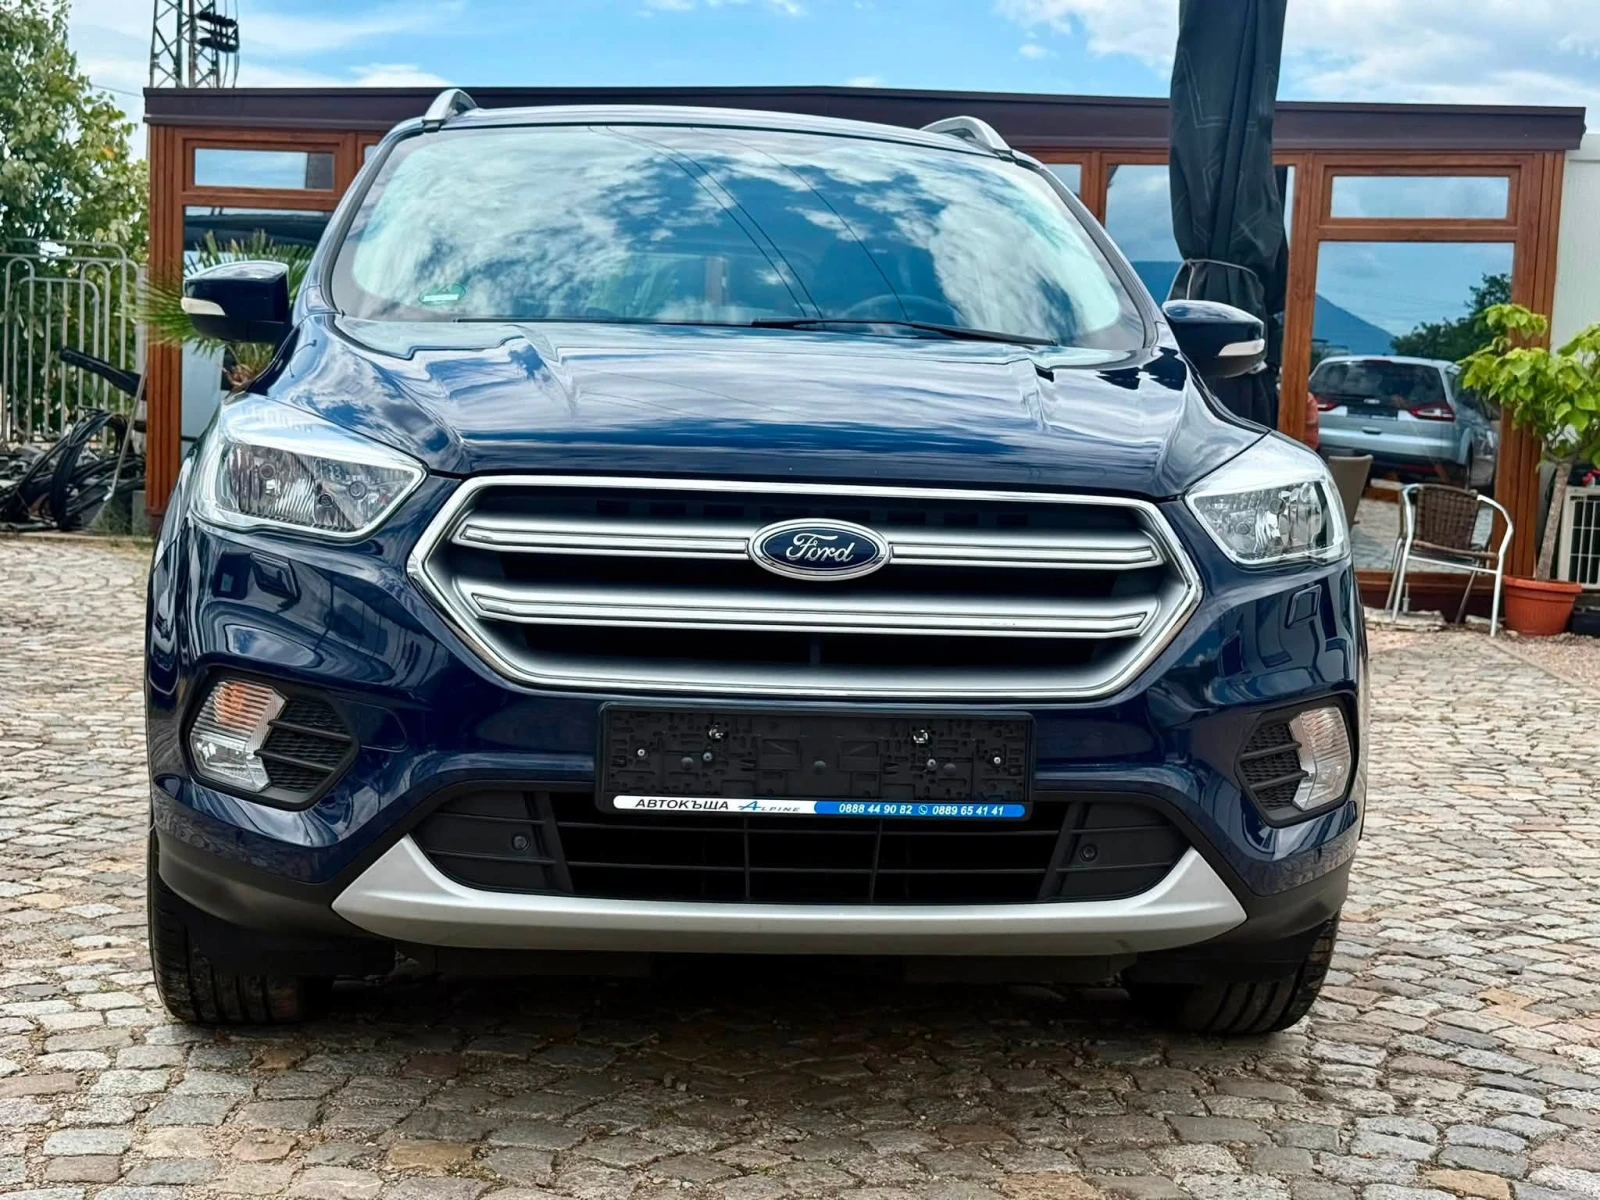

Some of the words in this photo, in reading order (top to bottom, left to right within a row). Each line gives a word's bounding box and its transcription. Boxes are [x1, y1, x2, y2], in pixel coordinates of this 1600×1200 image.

[785, 533, 855, 562] Ford
[838, 803, 865, 814] 0888
[867, 804, 881, 814] 44
[883, 804, 896, 815] 90
[899, 804, 913, 815] 82
[932, 805, 958, 816] 0889
[960, 805, 973, 816] 65
[975, 805, 988, 816] 41
[991, 806, 1004, 816] 41
